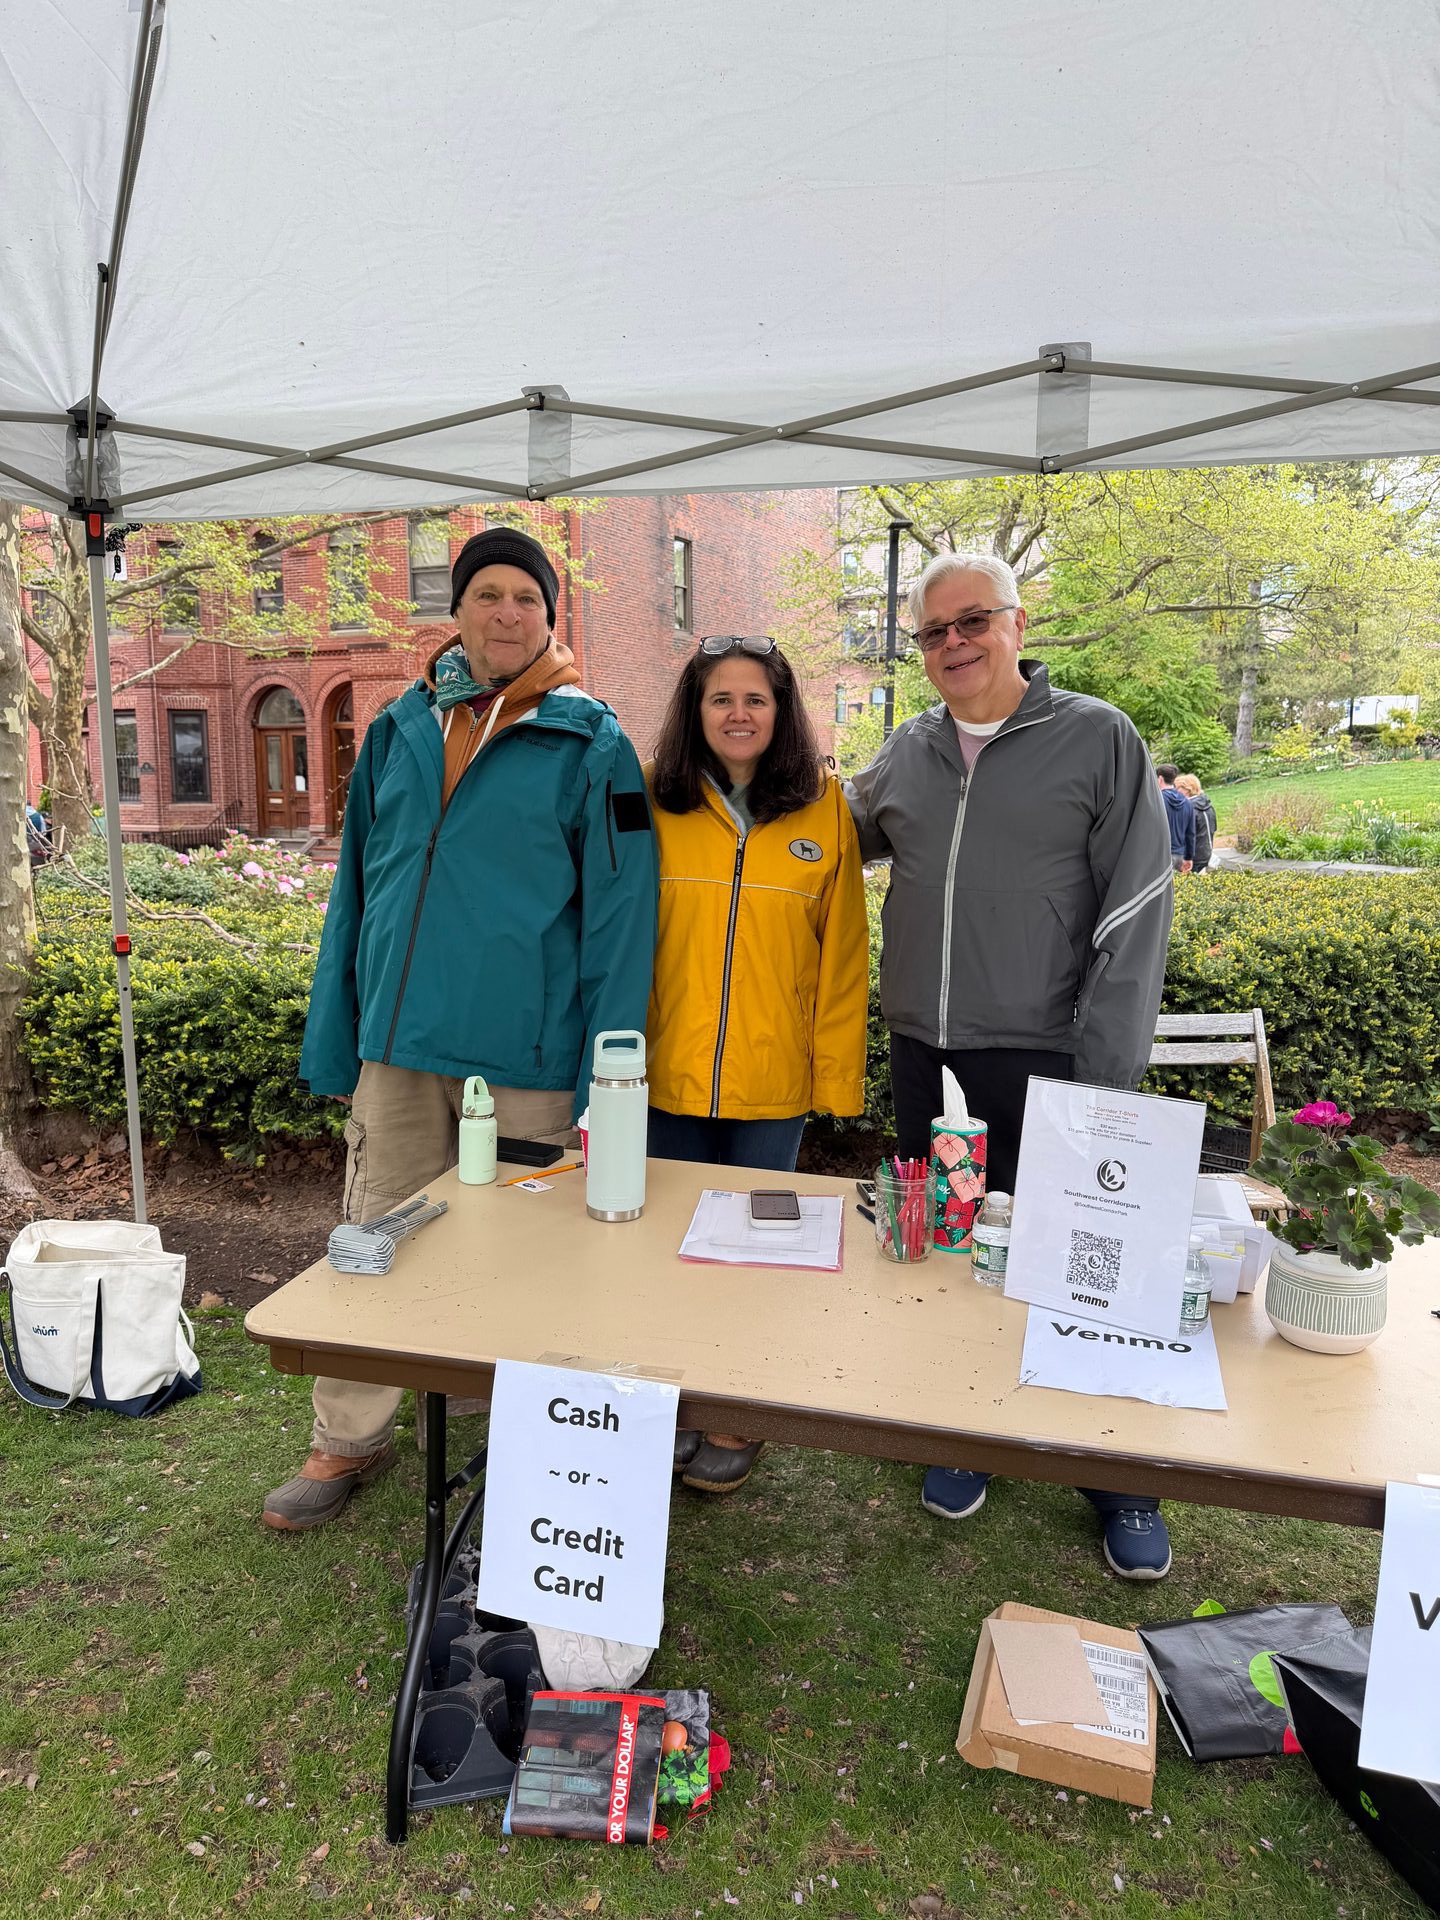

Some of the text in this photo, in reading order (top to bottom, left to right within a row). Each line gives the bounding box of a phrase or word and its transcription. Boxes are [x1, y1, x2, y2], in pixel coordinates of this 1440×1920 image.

[1096, 1106, 1118, 1115] Corridor
[1063, 1189, 1141, 1210] Southwest Corridorpark
[1074, 1201, 1128, 1216] @SouthwestCorridorPark
[1071, 1292, 1109, 1309] venmo
[1050, 1321, 1192, 1353] Venmo
[547, 1398, 620, 1432] Cash
[567, 1470, 591, 1485] or
[530, 1517, 625, 1559] Credit
[533, 1565, 604, 1602] Card
[611, 1777, 628, 1819] YOUR
